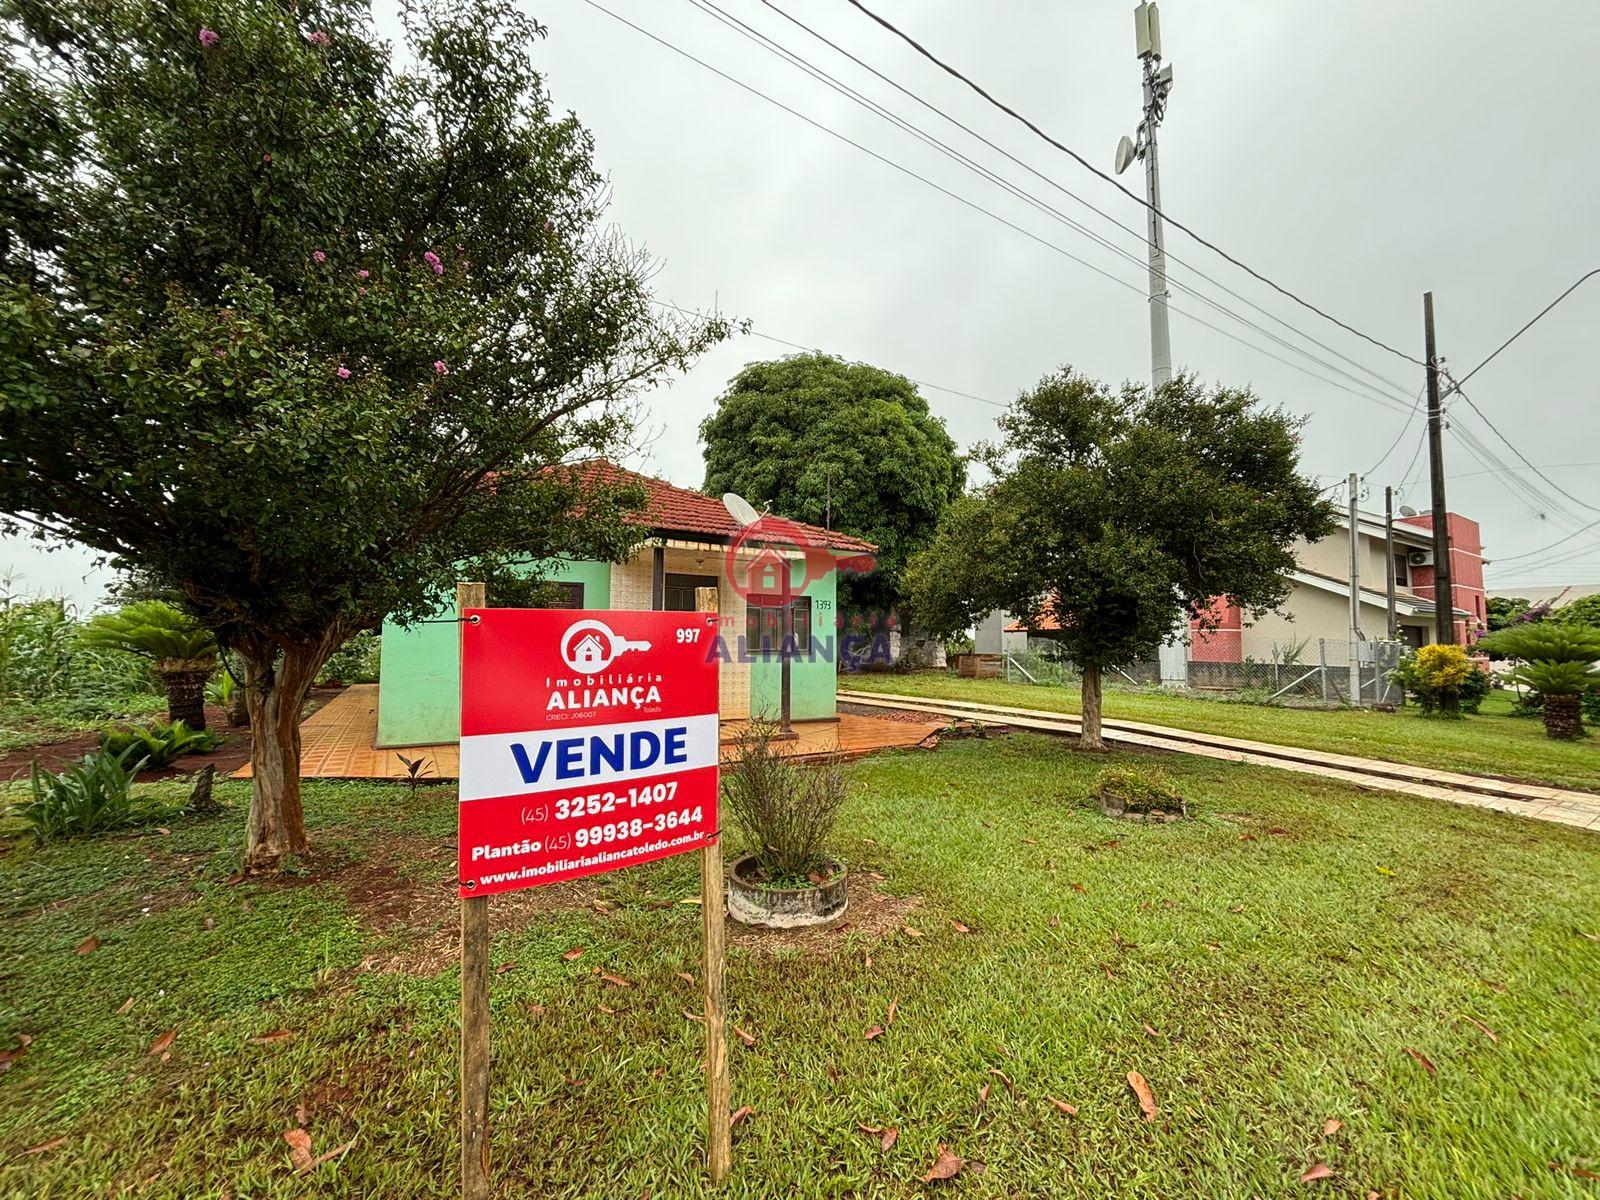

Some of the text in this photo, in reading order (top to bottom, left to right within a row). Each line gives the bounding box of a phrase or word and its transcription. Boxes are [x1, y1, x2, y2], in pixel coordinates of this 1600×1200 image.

[814, 599, 832, 610] 1393
[676, 628, 701, 644] 997
[546, 673, 663, 688] Imobiliária
[547, 686, 662, 709] ALIANÇA
[642, 706, 662, 714] Toledo
[510, 727, 687, 784] VENDE
[522, 782, 678, 825] (45) 3252-1407
[471, 806, 703, 861] Plantão (45) 99938-3644
[480, 830, 704, 885] www.imobiliariaaliancatoledo.com.br
